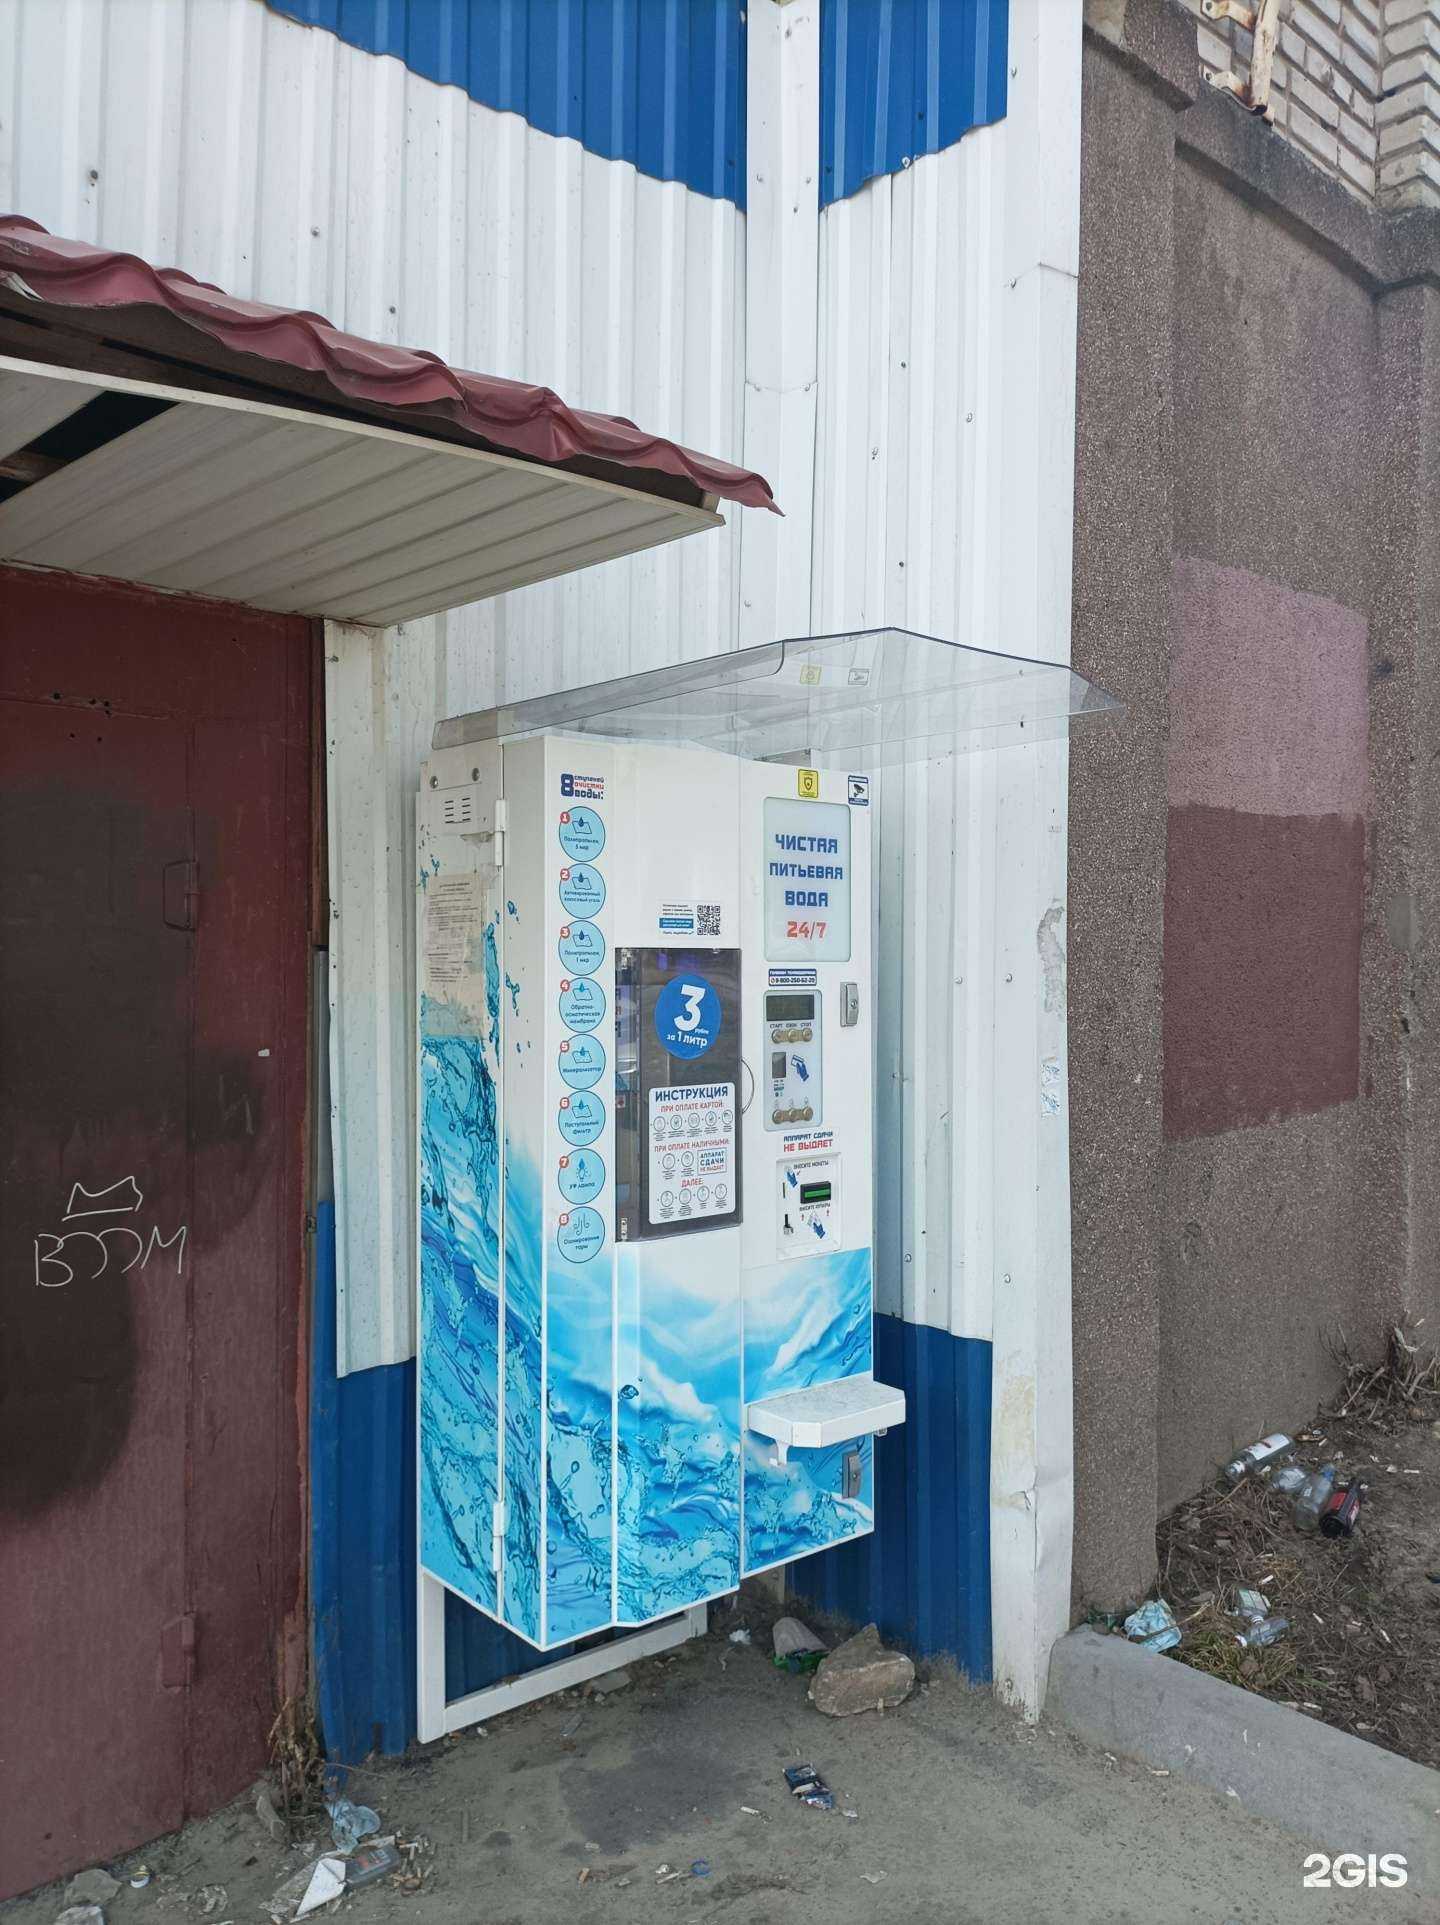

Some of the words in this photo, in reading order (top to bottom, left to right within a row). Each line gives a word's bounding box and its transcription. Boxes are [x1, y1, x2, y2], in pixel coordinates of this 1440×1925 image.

[561, 773, 574, 797] 8
[575, 789, 604, 800] воды:
[775, 834, 838, 854] ЧИСТАЯ
[769, 862, 843, 880] ПИТЬЕВАЯ
[784, 890, 829, 907] ВОДА
[786, 920, 827, 940] 24/7
[674, 983, 706, 1031] 3
[677, 1031, 682, 1042] 1
[683, 1034, 708, 1048] литр
[655, 1086, 728, 1102] ИНСТРУКЦИЯ
[675, 1103, 698, 1111] ОПЛАТЕ
[783, 1133, 811, 1142] АППАРАТ
[813, 1131, 833, 1139] СДАЧИ
[784, 1142, 795, 1152] НЕ
[798, 1139, 833, 1151] ВЫДАЕТ
